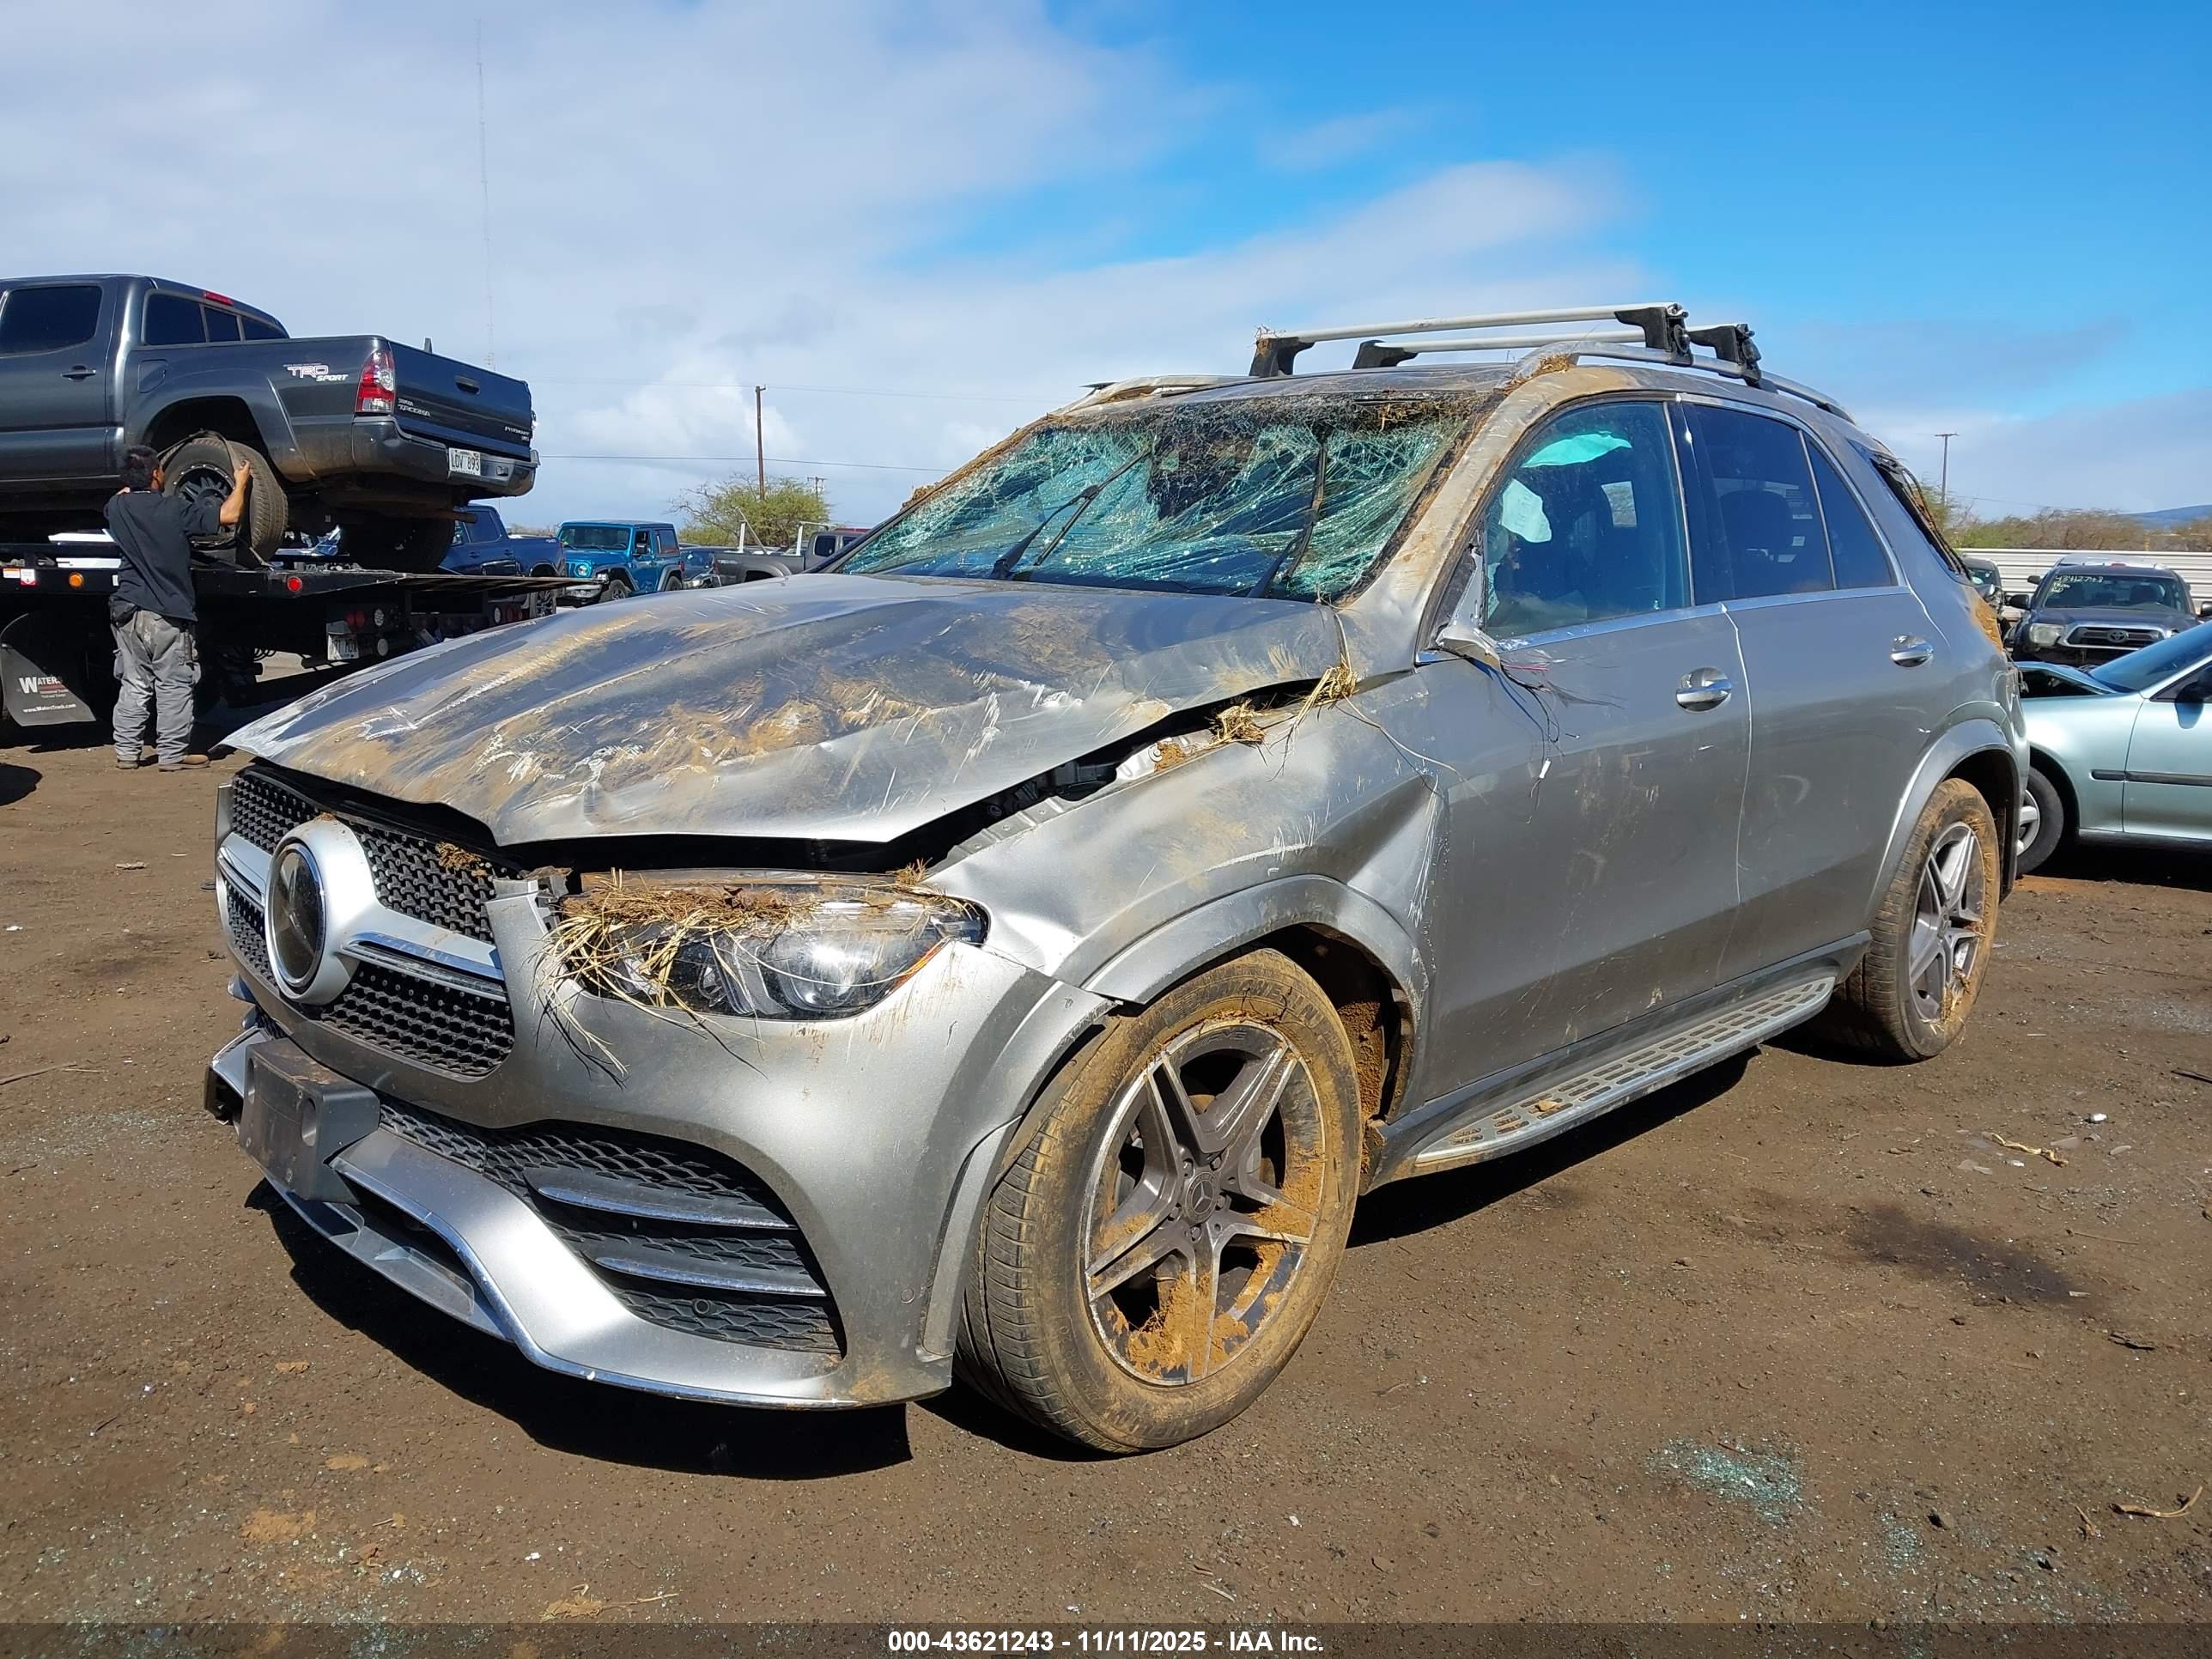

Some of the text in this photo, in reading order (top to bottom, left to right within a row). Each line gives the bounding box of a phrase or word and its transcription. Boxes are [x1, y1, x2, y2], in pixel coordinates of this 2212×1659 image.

[287, 365, 329, 379] TRD
[315, 374, 349, 382] SPORT
[467, 456, 480, 471] 893
